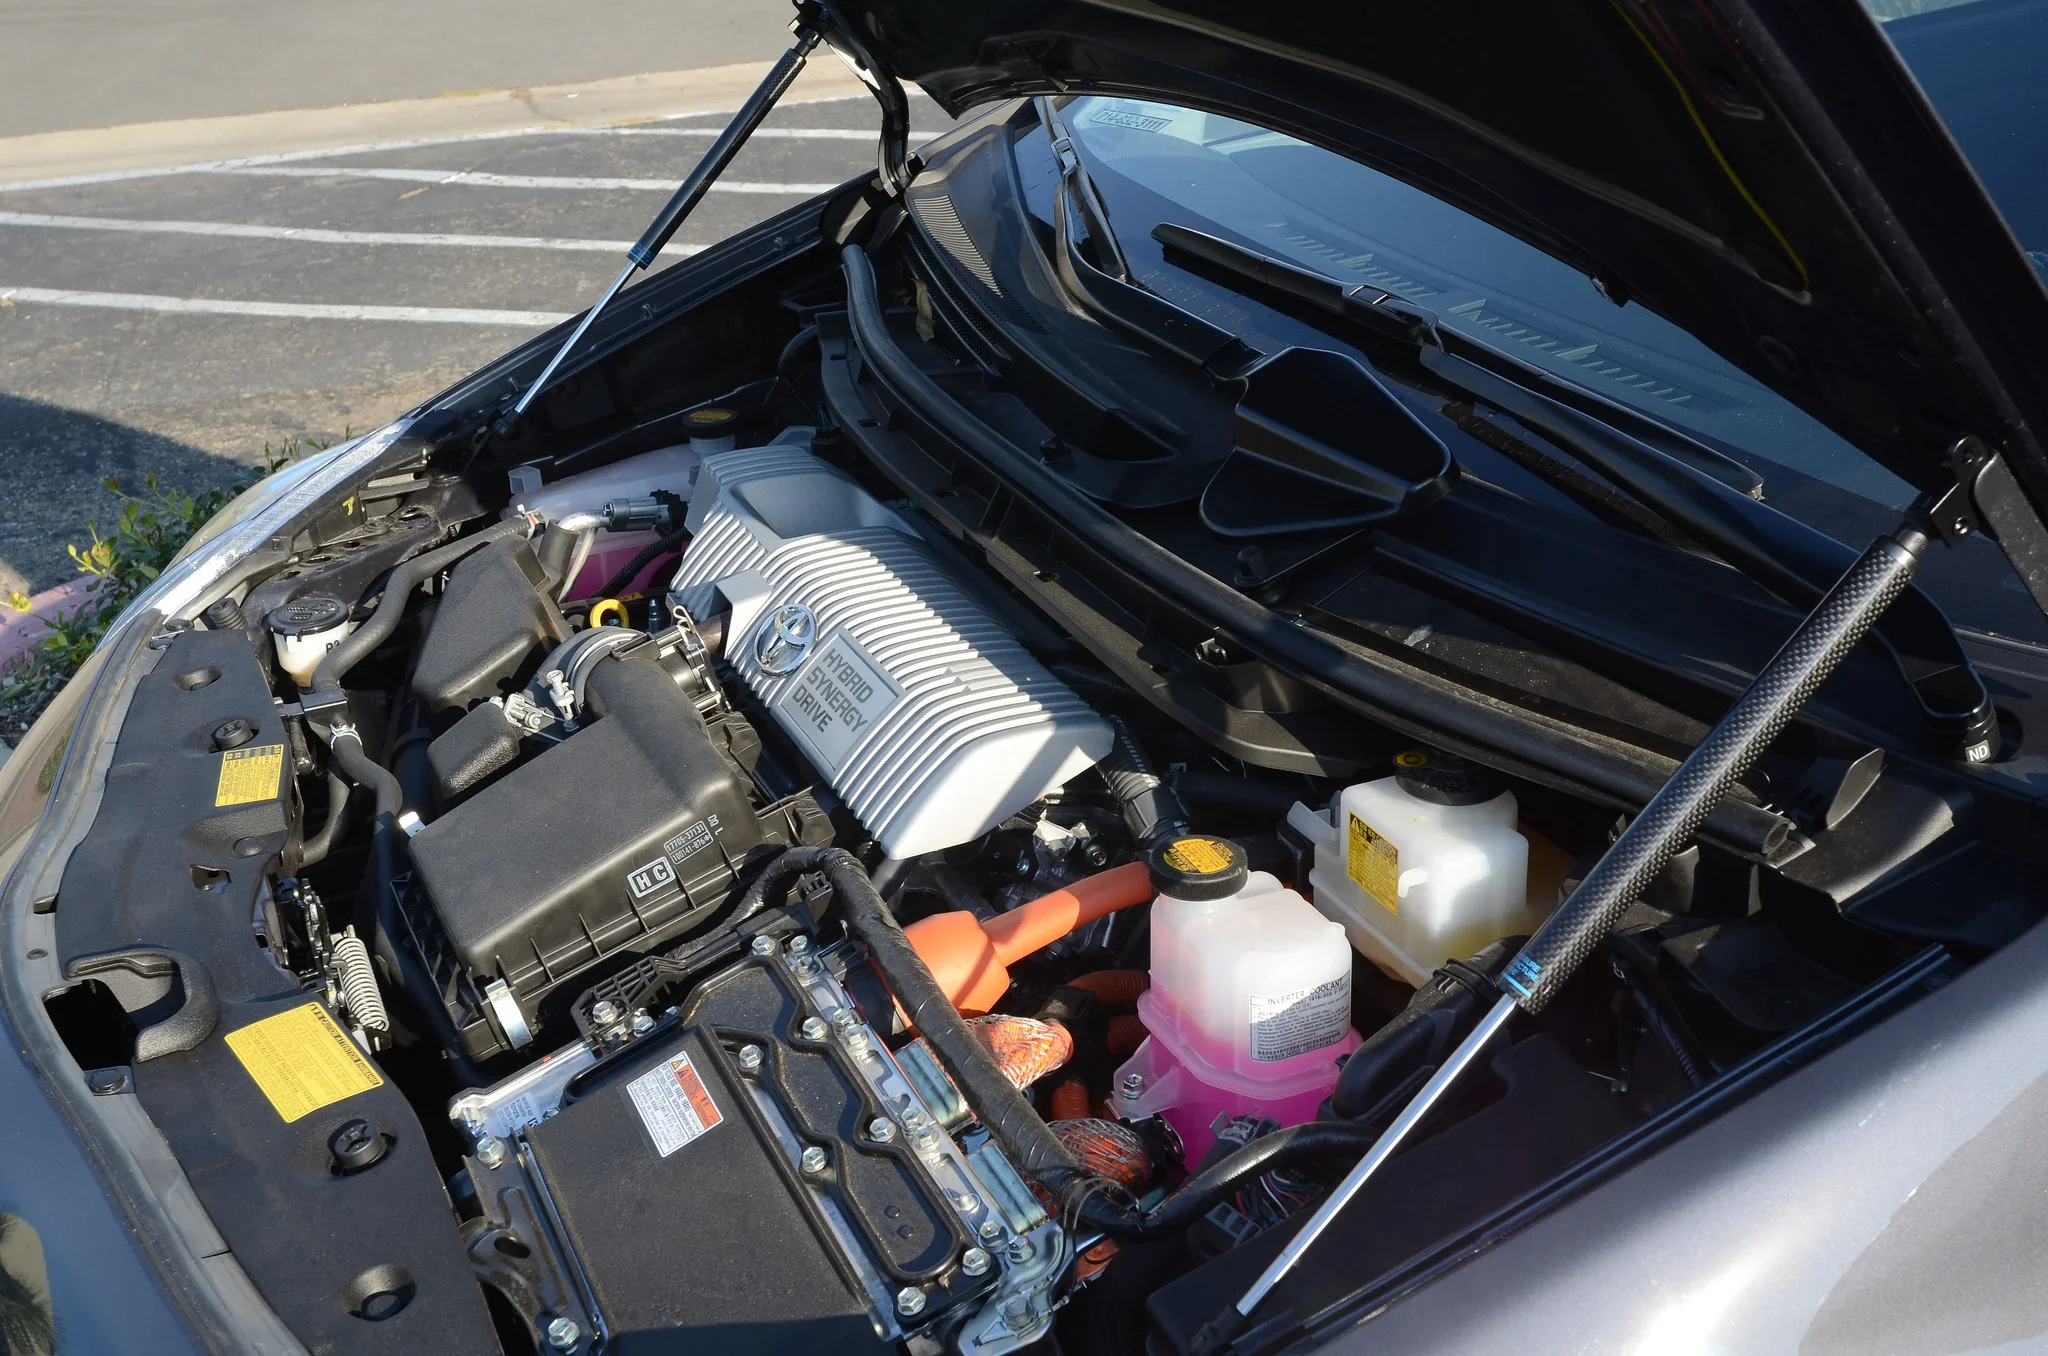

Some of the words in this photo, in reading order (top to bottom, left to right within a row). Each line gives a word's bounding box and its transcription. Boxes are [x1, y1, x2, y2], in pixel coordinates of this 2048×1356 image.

[822, 648, 873, 704] HYBRID
[792, 685, 833, 733] DRIVE
[807, 667, 869, 733] SYNERGY
[1968, 745, 1987, 761] ND
[666, 823, 705, 851] 17705-37131
[1267, 990, 1304, 1005] INVERTER
[1310, 978, 1342, 995] COOLANT
